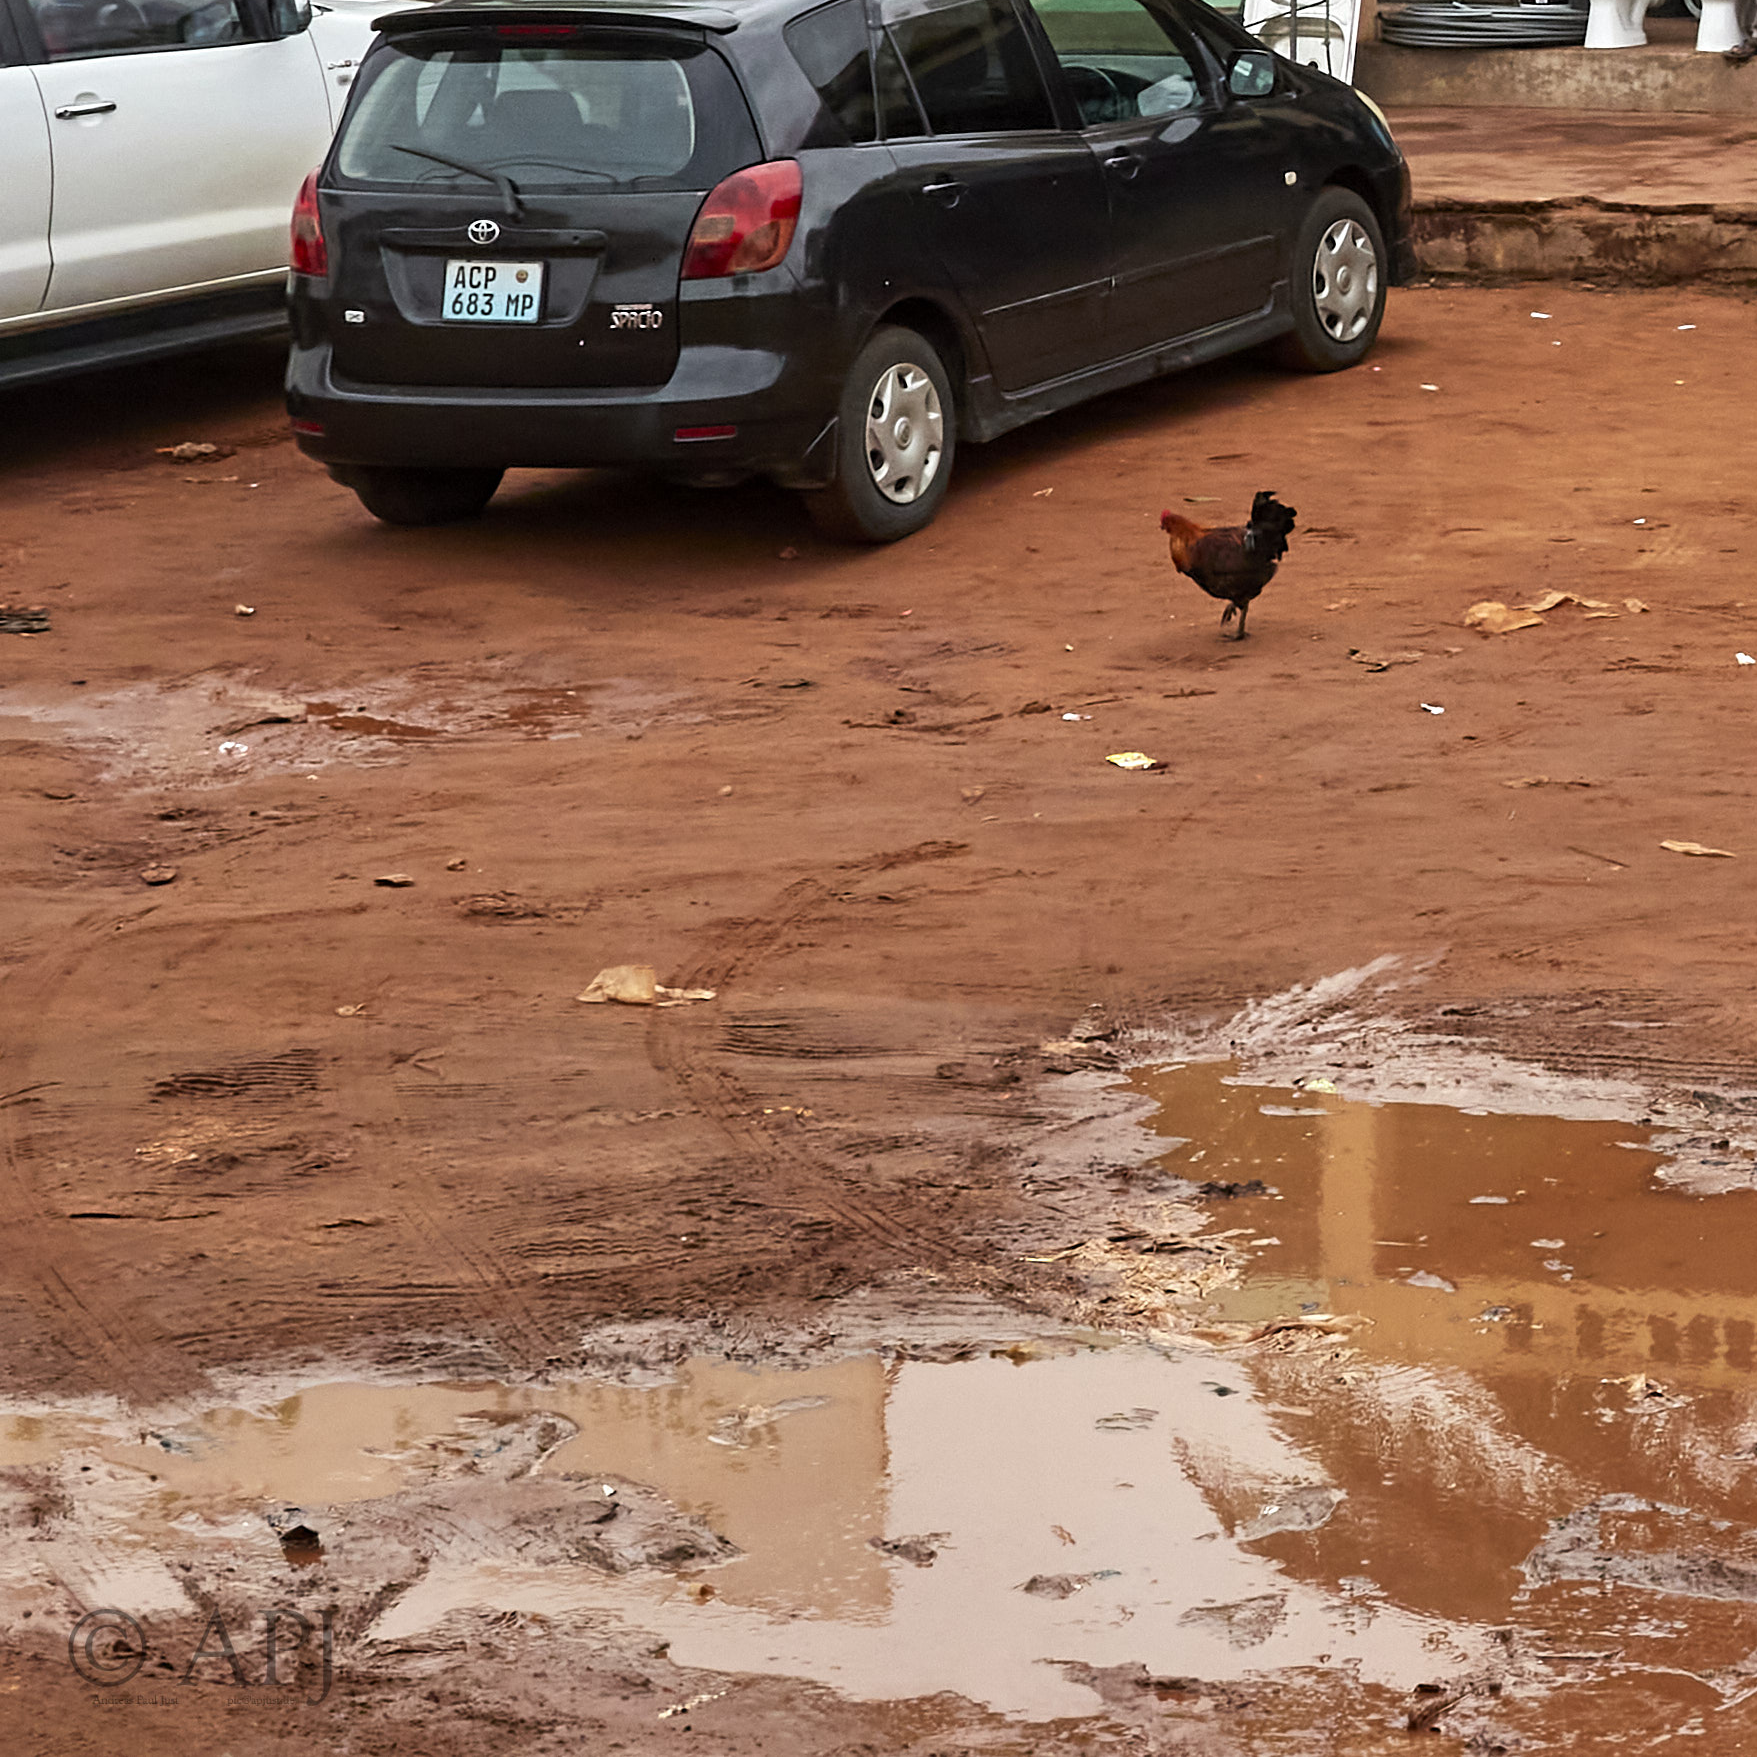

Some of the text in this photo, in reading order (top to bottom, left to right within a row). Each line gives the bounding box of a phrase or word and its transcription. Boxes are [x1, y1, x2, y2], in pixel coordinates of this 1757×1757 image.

[454, 265, 496, 289] ACP
[452, 292, 534, 316] 683 MP
